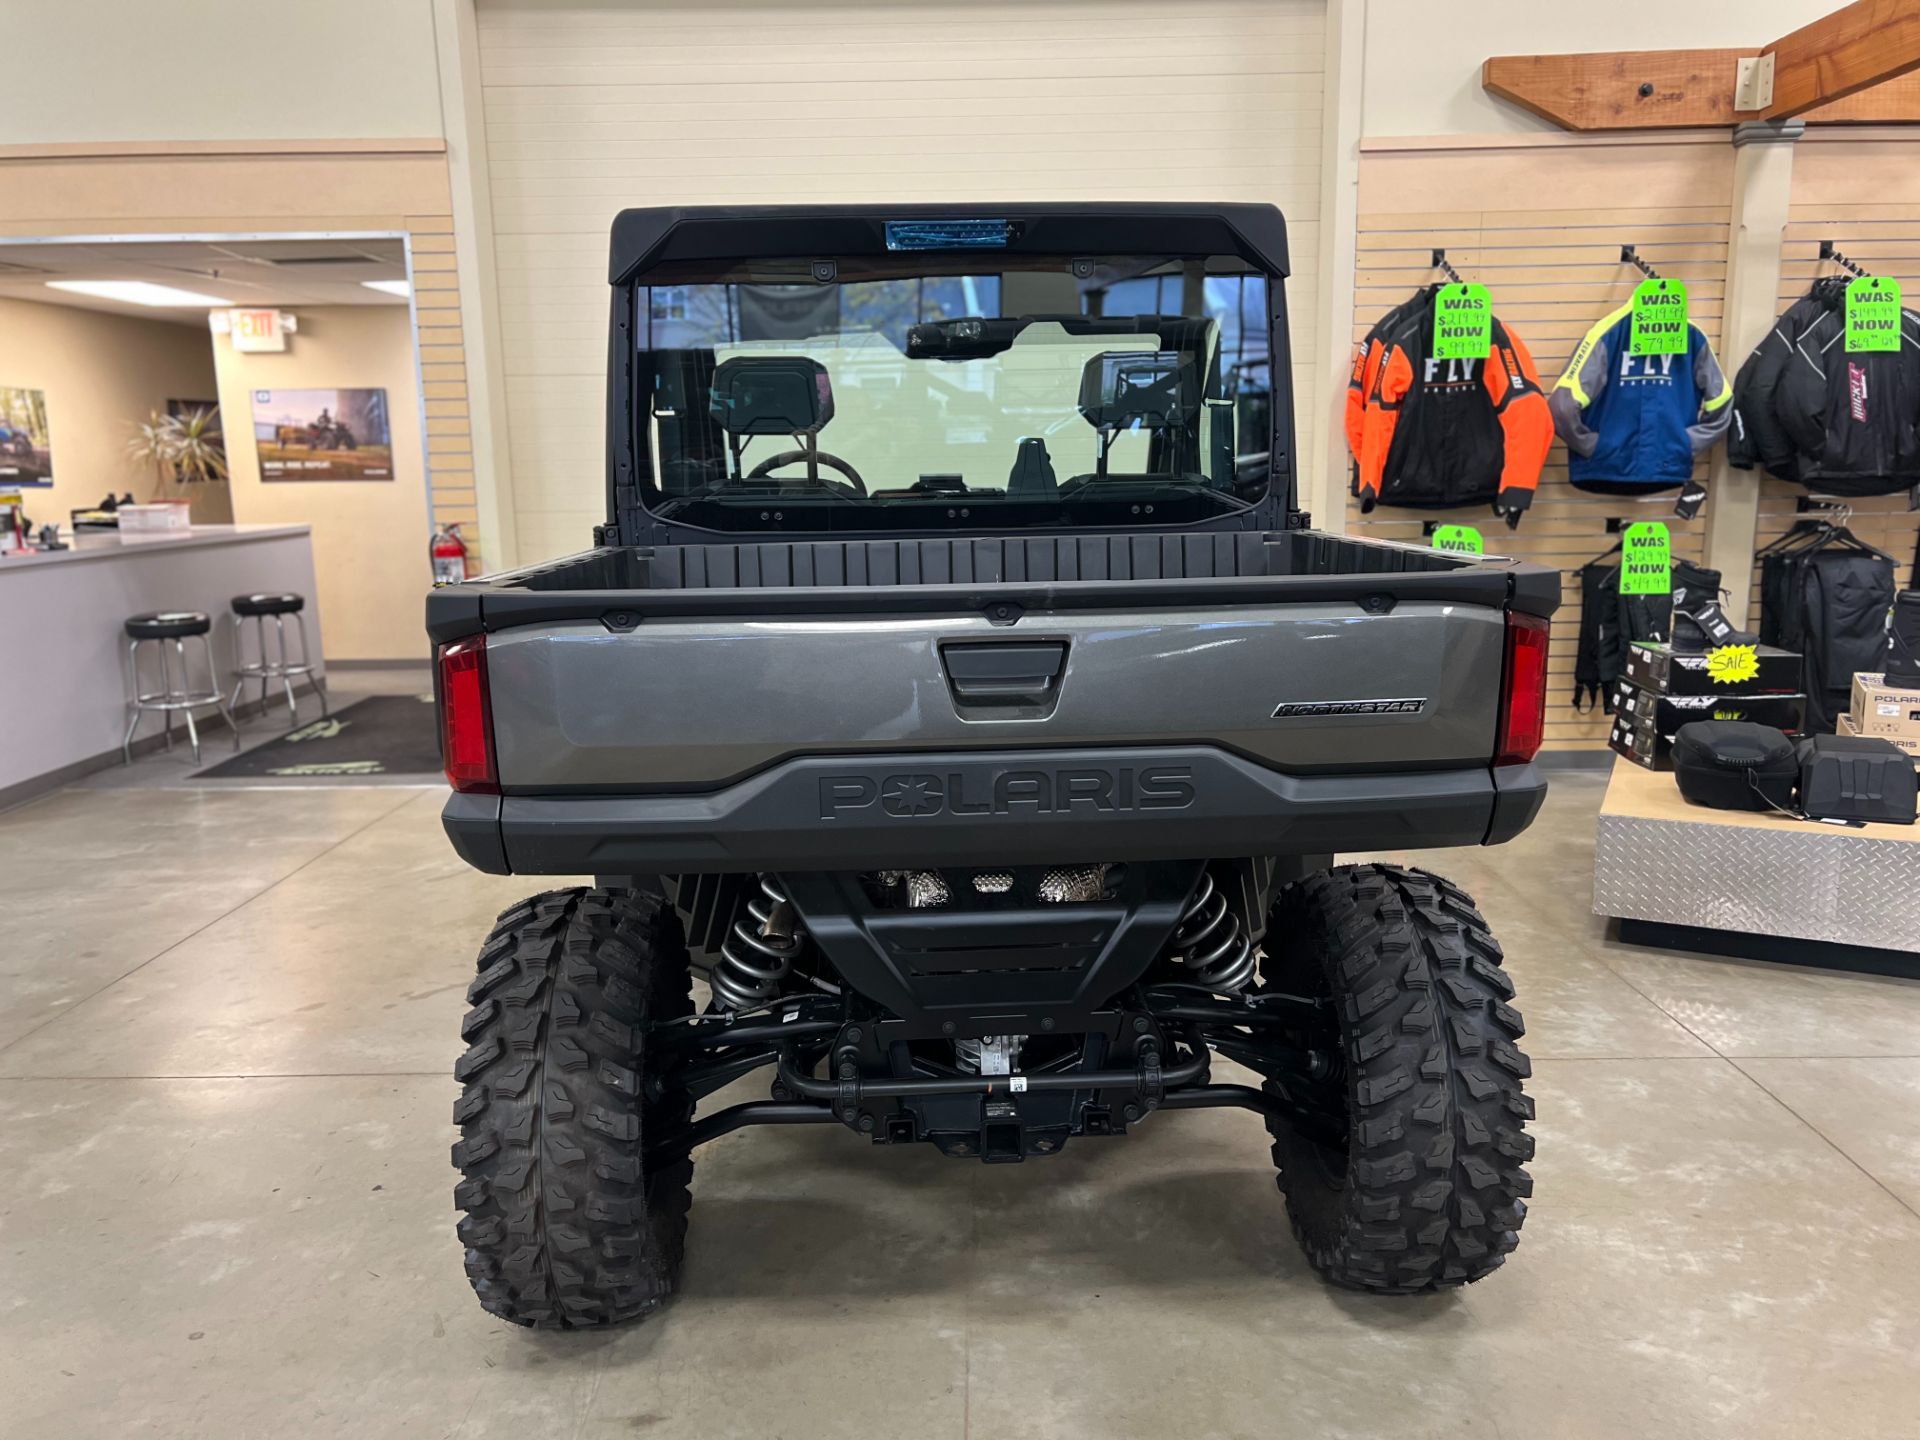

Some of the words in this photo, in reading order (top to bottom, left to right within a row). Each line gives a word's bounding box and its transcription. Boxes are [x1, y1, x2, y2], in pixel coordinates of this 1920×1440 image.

[1641, 294, 1681, 306] WAS
[1854, 292, 1894, 303] WAS
[1444, 299, 1484, 310] WAS
[240, 310, 272, 337] EXIT
[1638, 322, 1681, 334] NOW
[1853, 320, 1894, 331] NOW
[1441, 327, 1484, 338] NOW
[1621, 351, 1673, 376] FLY
[1424, 358, 1476, 383] FLY
[1440, 540, 1476, 552] WAS
[1631, 537, 1665, 548] WAS
[1628, 564, 1665, 574] NOW
[1712, 653, 1749, 672] SALE
[1279, 701, 1420, 717] NORTHSTAR
[818, 766, 1196, 820] POLARIS
